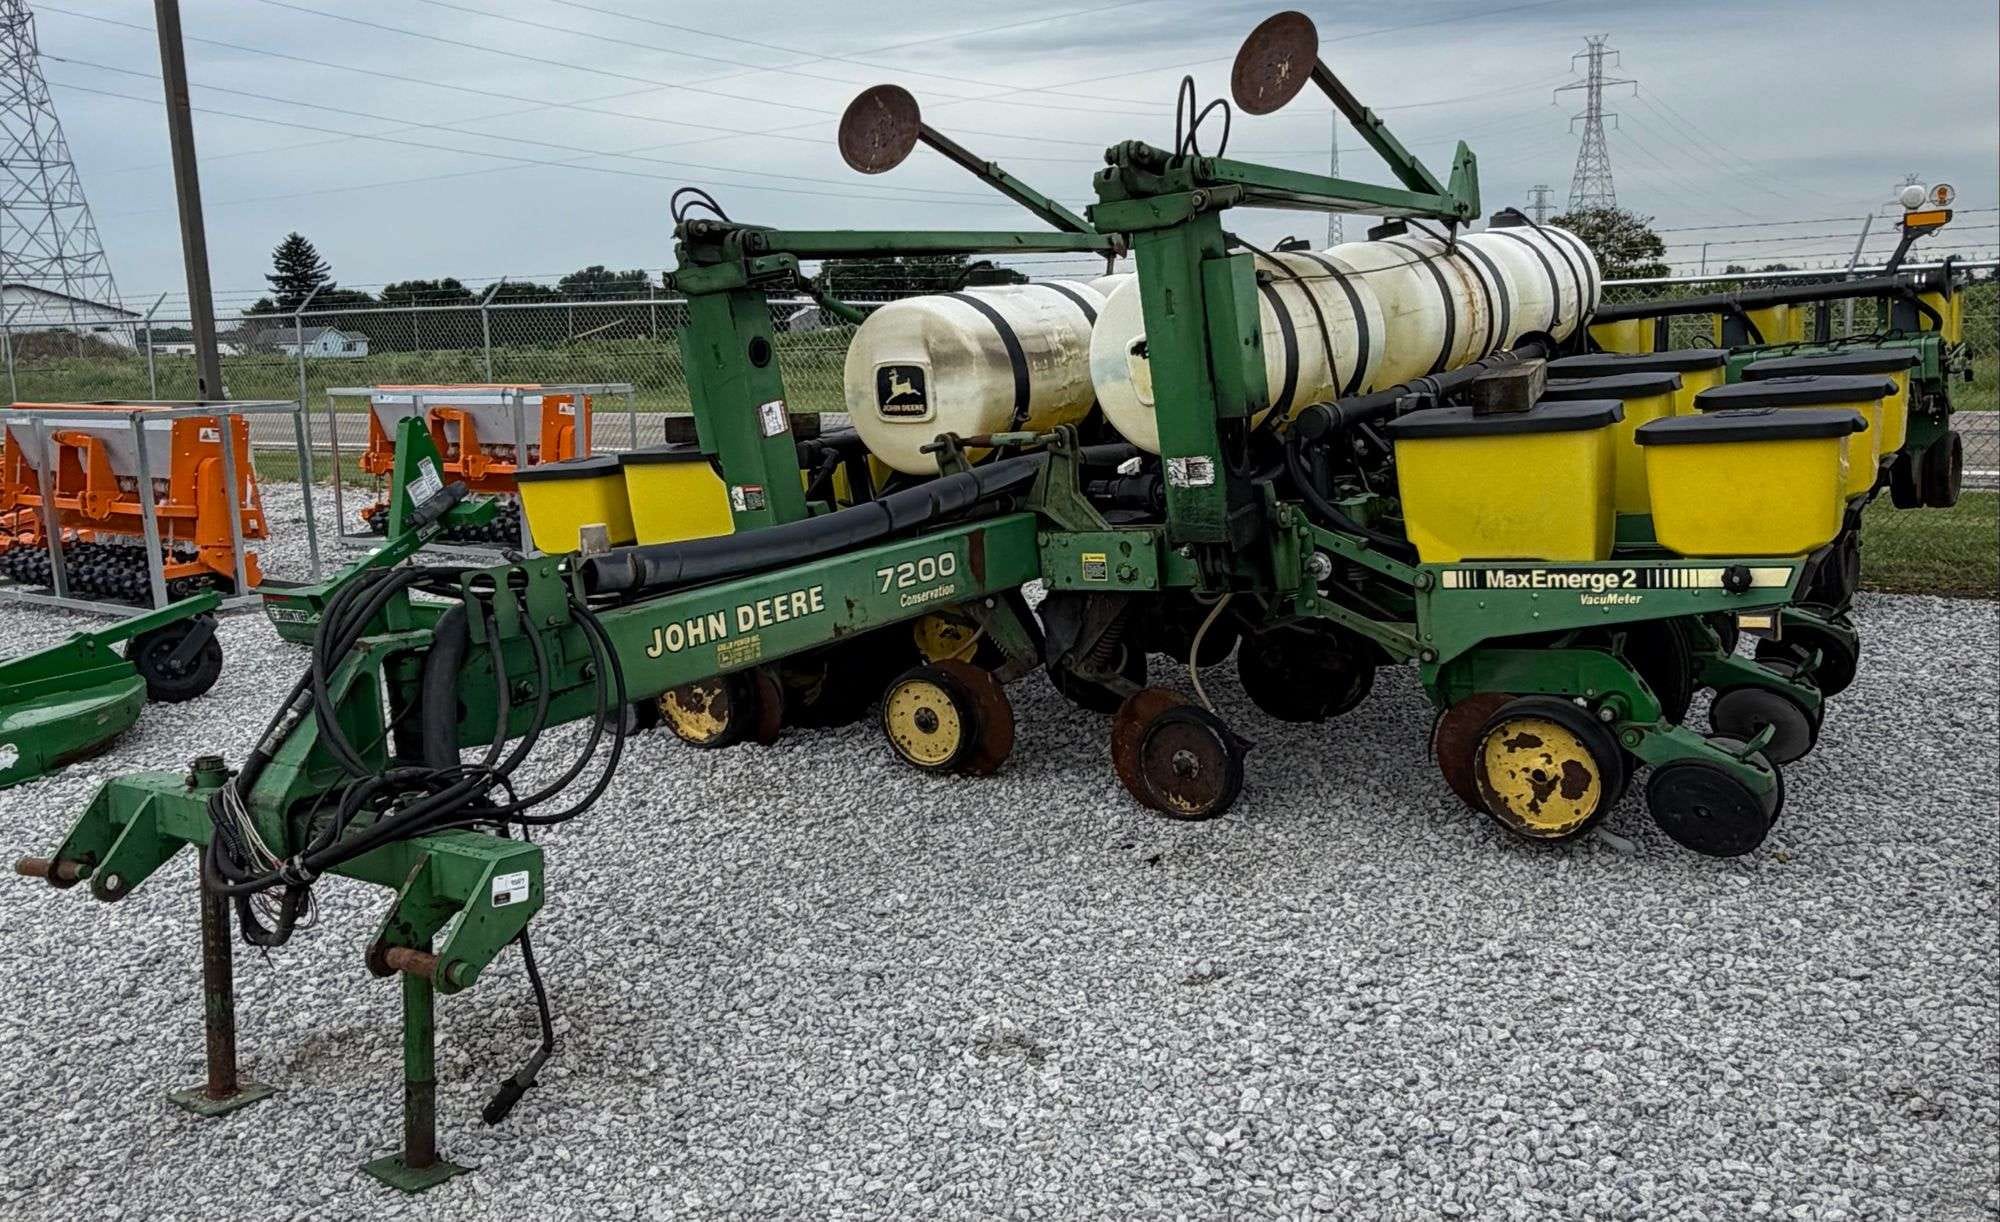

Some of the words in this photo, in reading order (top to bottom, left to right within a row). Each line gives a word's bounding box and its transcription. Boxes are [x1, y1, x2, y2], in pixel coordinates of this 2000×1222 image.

[876, 551, 957, 595] 7200
[1485, 569, 1620, 592] MaxEmerge
[1622, 568, 1638, 588] 2
[900, 584, 955, 608] Conservation
[1580, 593, 1643, 605] VacuMeter
[646, 610, 728, 659] JOHN
[735, 584, 826, 634] DEERE
